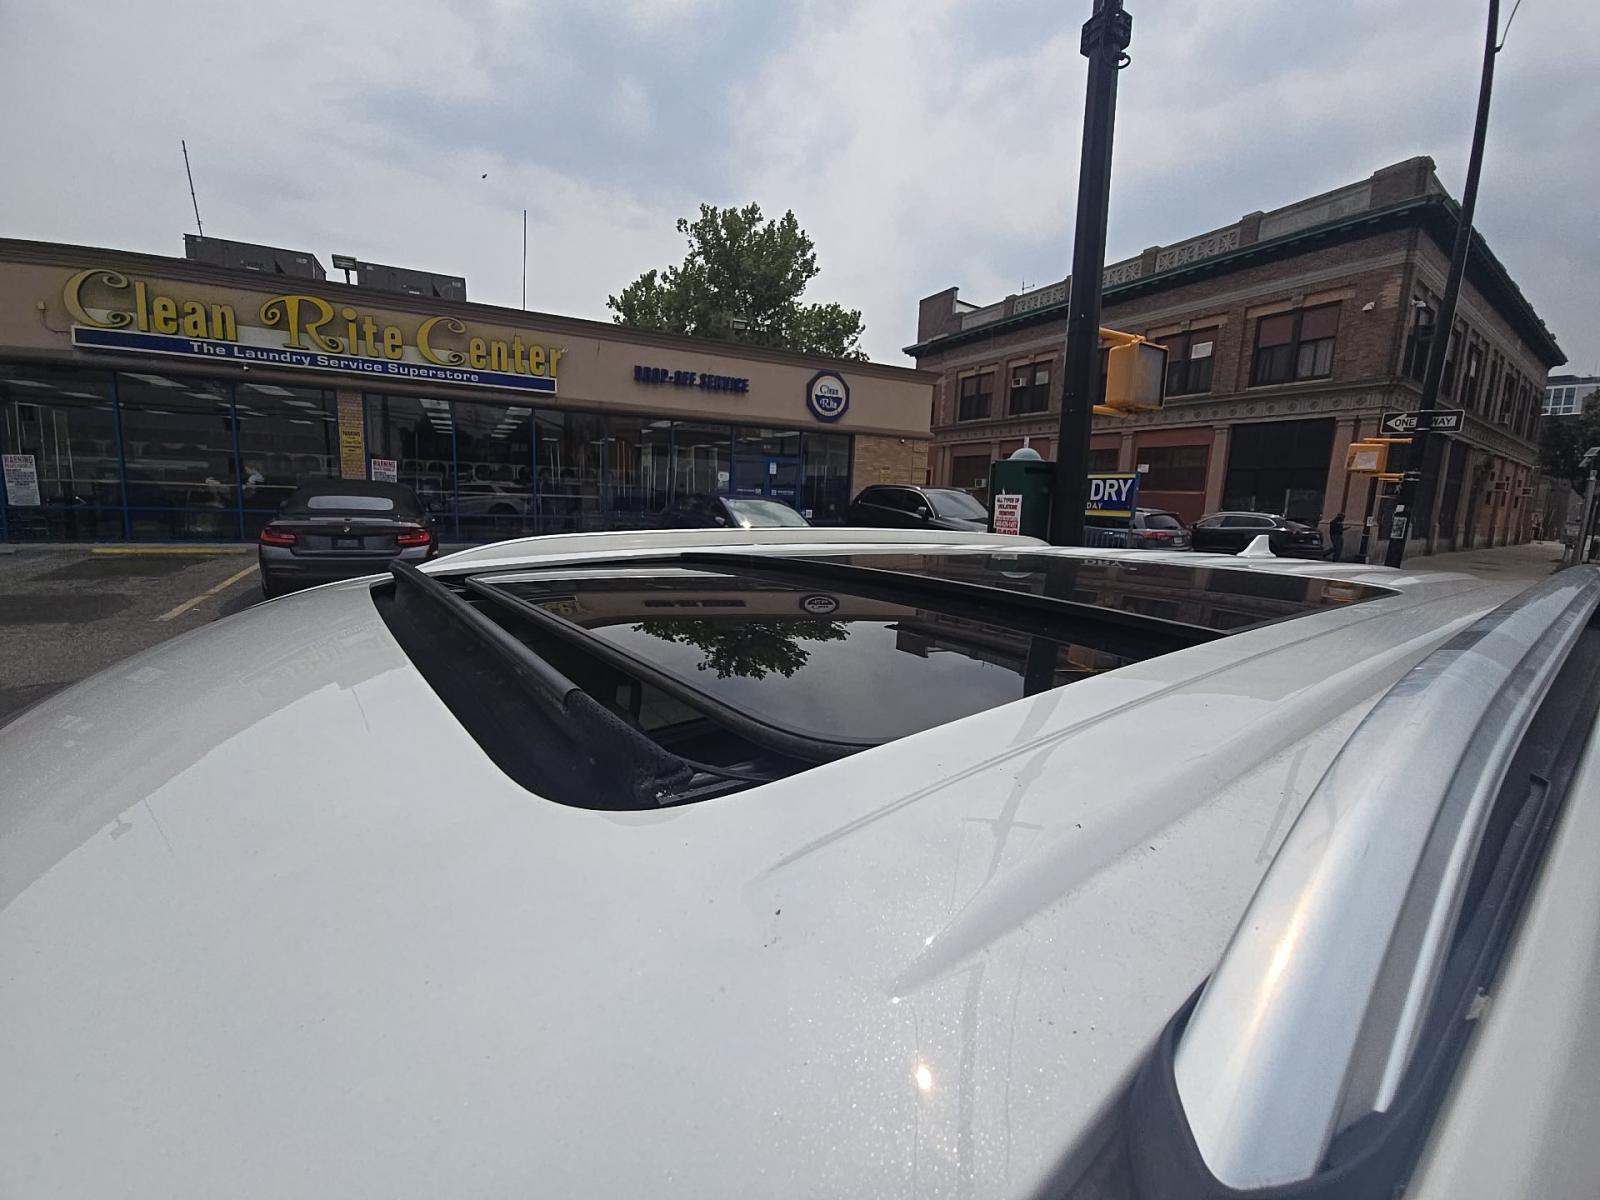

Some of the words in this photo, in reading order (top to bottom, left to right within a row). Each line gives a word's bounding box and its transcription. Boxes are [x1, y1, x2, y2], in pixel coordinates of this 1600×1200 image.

[63, 268, 238, 342] Clean
[259, 295, 404, 360] Rite
[416, 315, 563, 379] Center
[189, 341, 226, 355] The
[233, 346, 311, 366] Laundry
[316, 355, 383, 372] Service
[388, 363, 479, 382] Superstore
[634, 365, 696, 386] DROP-OFF
[699, 373, 750, 393] SERVICE
[1394, 418, 1415, 427] ONE
[1086, 501, 1103, 510] DAY
